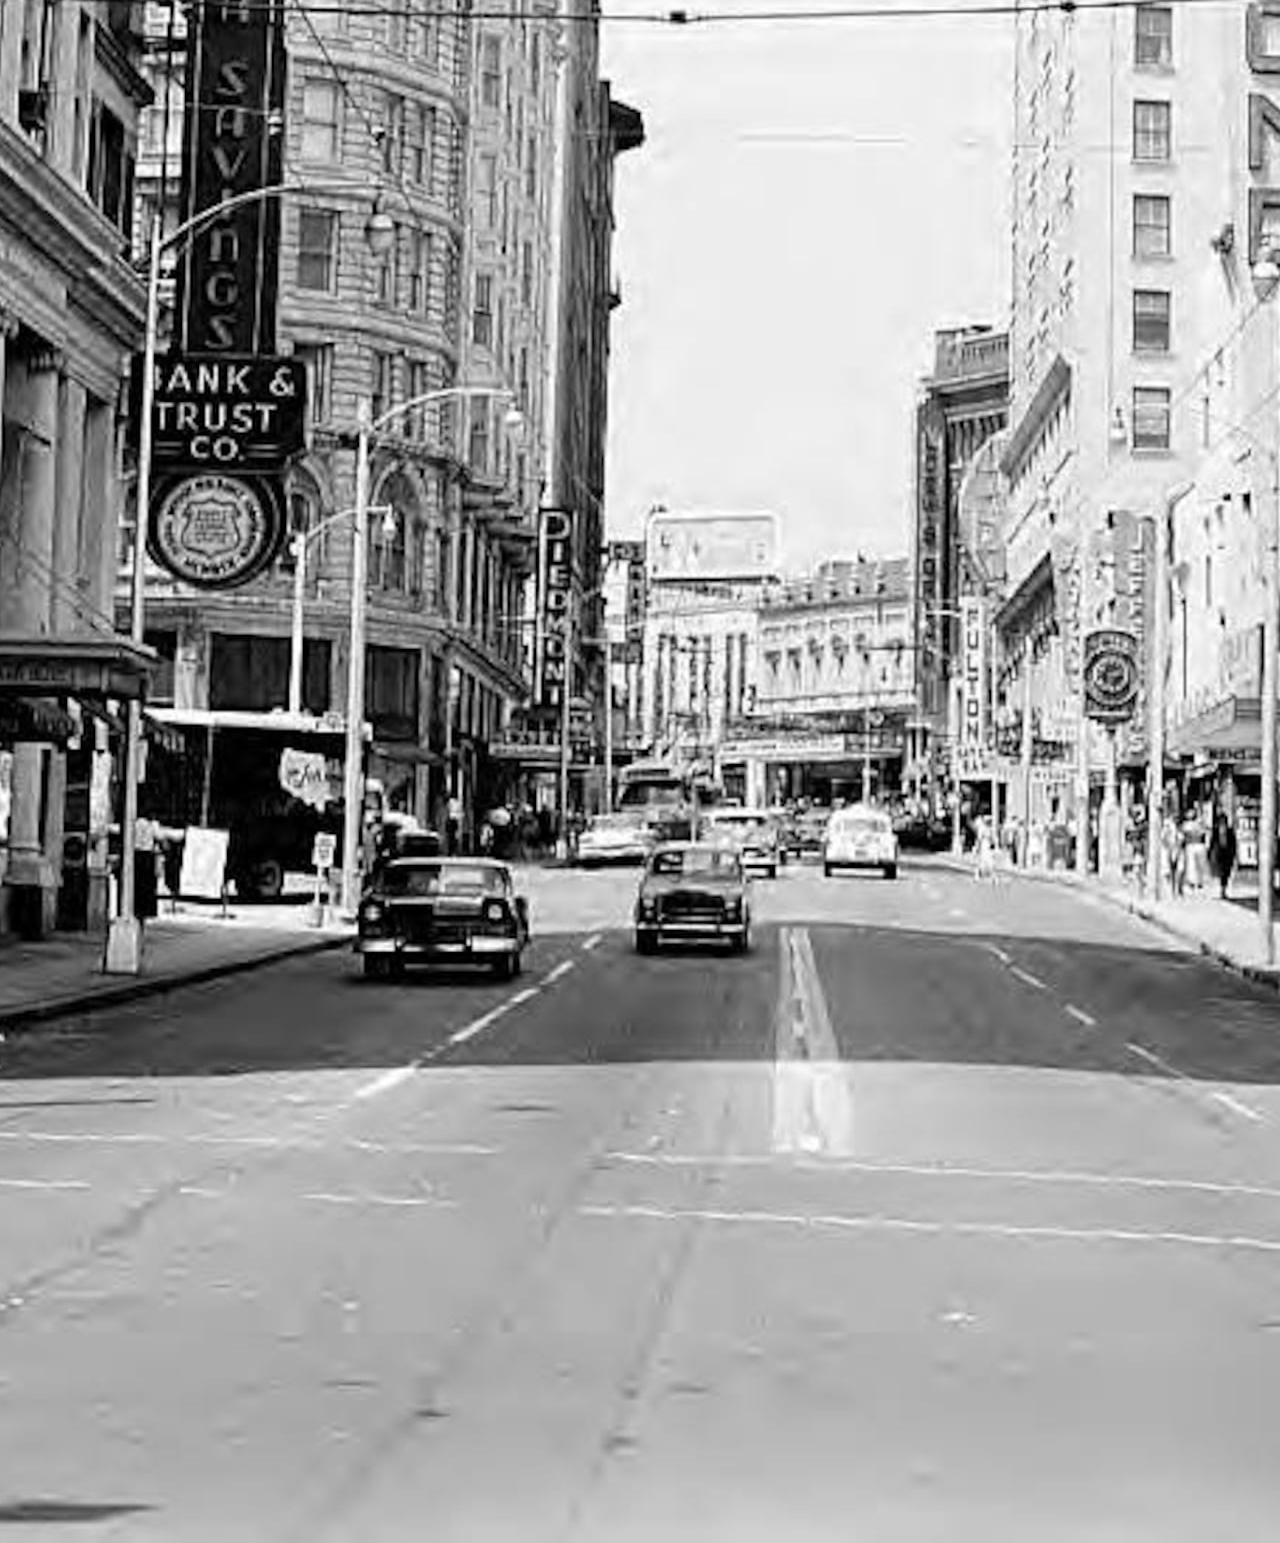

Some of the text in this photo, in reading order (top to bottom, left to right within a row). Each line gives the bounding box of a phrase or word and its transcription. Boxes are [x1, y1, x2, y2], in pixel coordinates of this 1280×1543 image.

[205, 60, 249, 350] SAVINGS
[269, 365, 296, 397] &
[154, 401, 278, 434] TRUST
[190, 434, 247, 462] CO.
[540, 510, 571, 705] PIEDMONT
